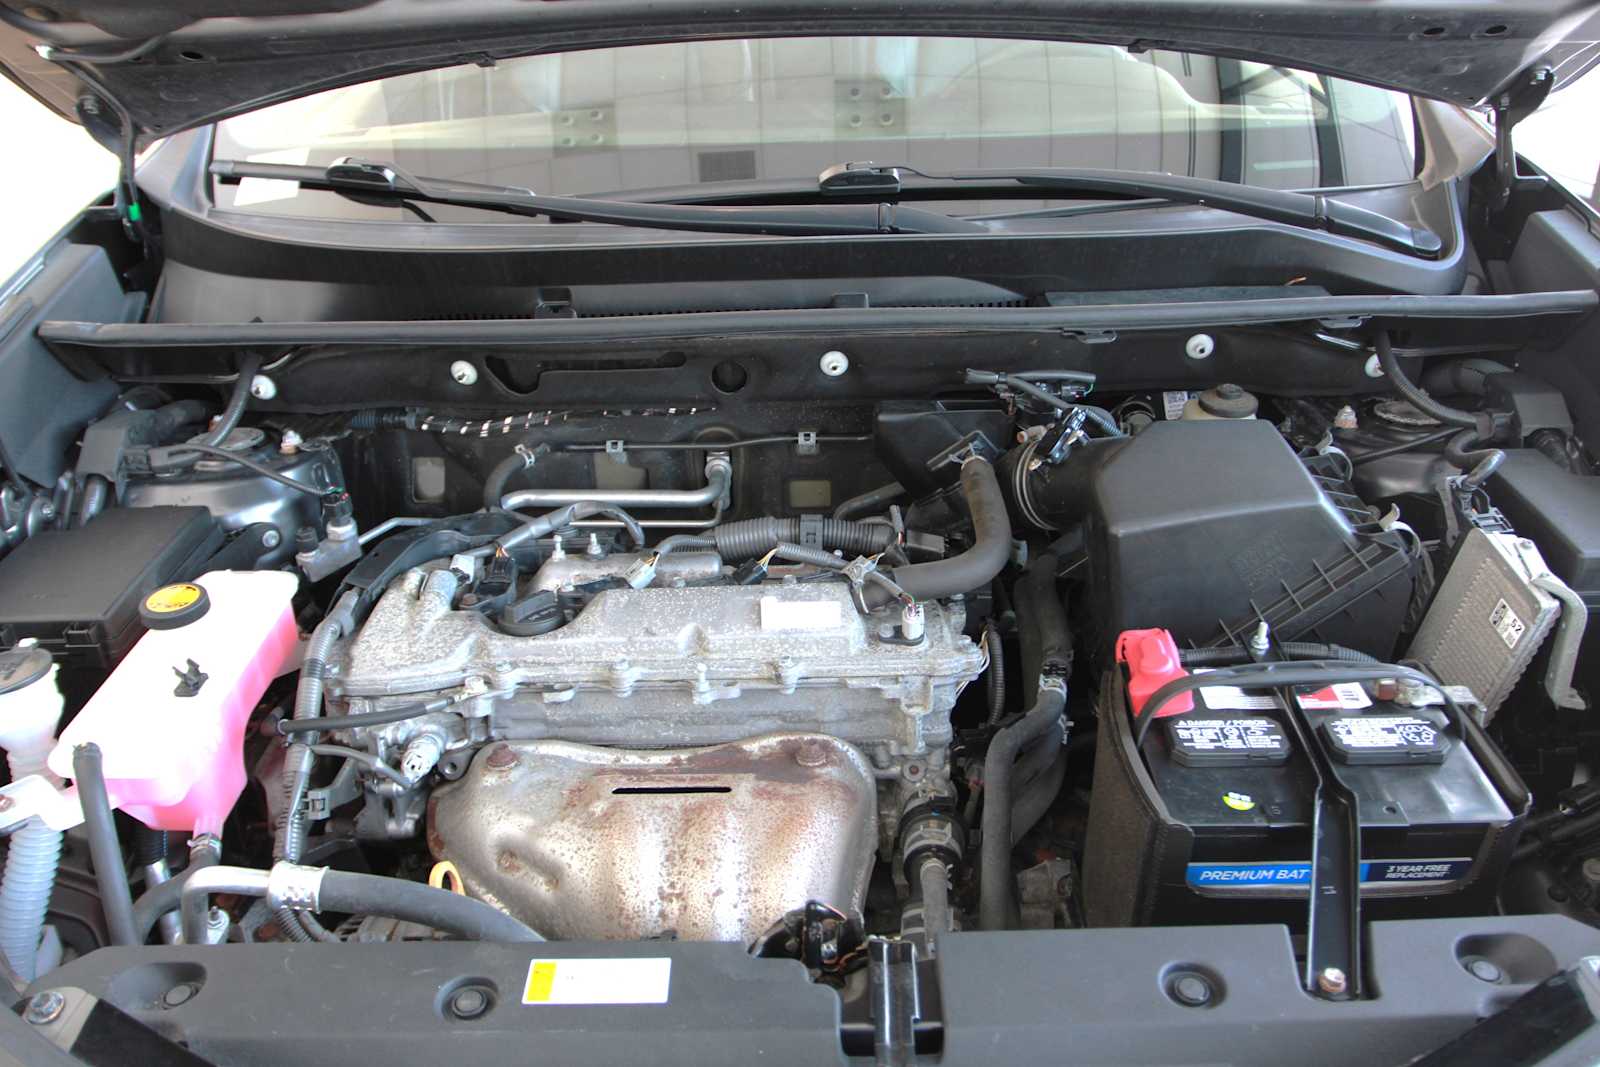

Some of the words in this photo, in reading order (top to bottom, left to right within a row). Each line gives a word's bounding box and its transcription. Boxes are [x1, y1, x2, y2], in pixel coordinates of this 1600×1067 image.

[1397, 865, 1424, 873] YEAR
[1424, 864, 1452, 872] FREE
[1200, 870, 1275, 881] PREMIUM
